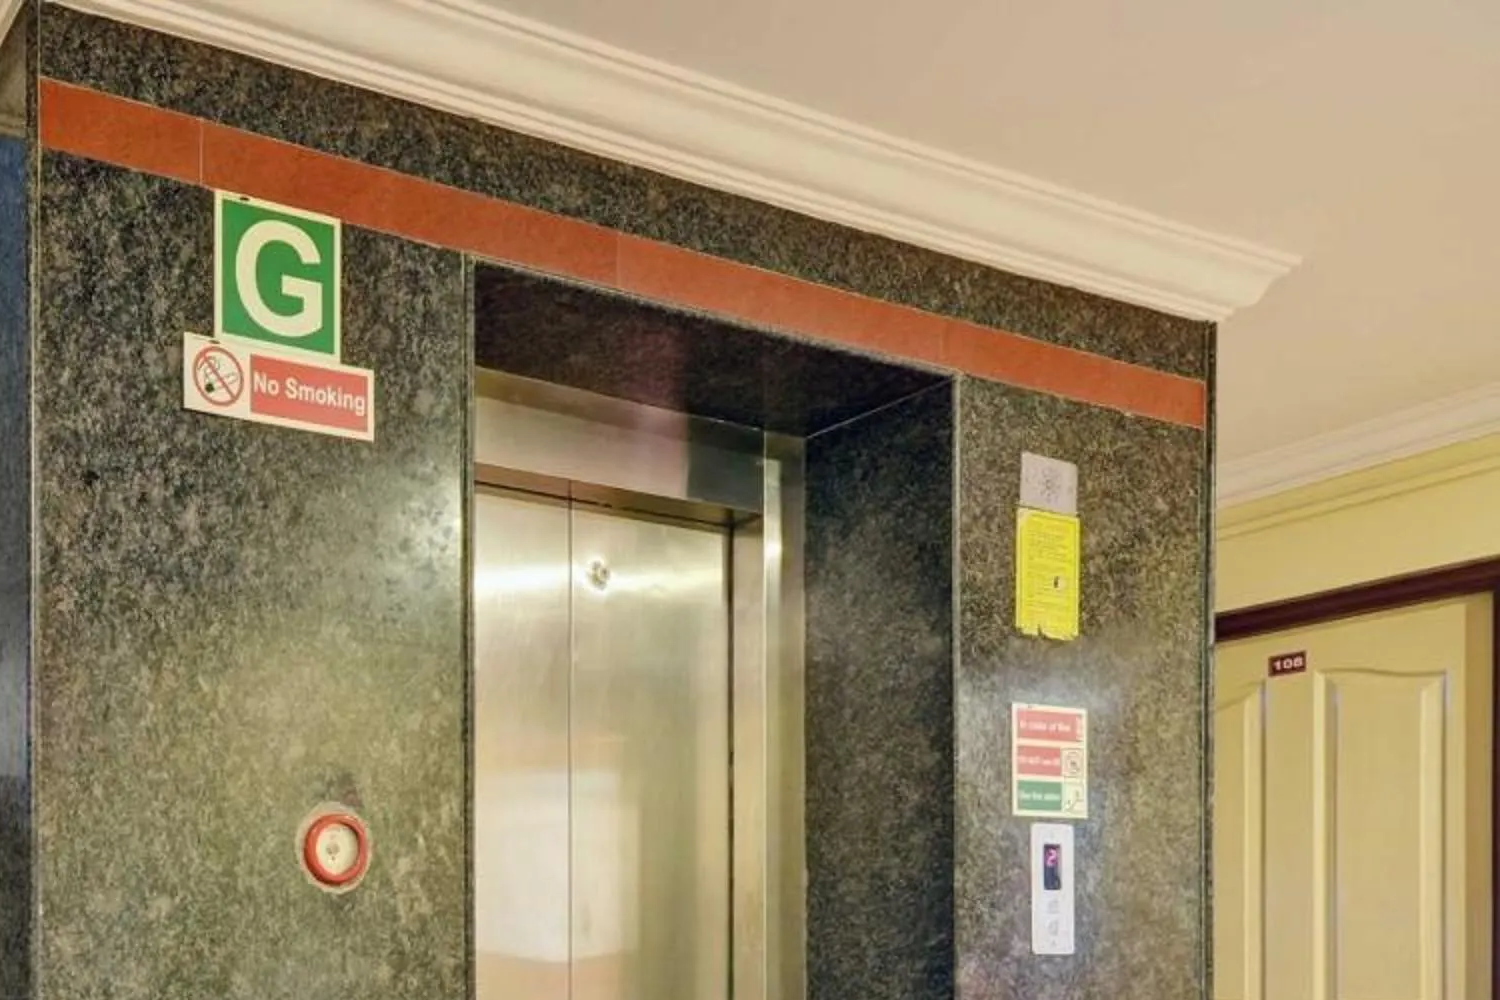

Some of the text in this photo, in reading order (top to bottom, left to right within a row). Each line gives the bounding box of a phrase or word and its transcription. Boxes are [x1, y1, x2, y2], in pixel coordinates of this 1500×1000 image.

[235, 219, 324, 338] G
[253, 371, 366, 416] No Smoking
